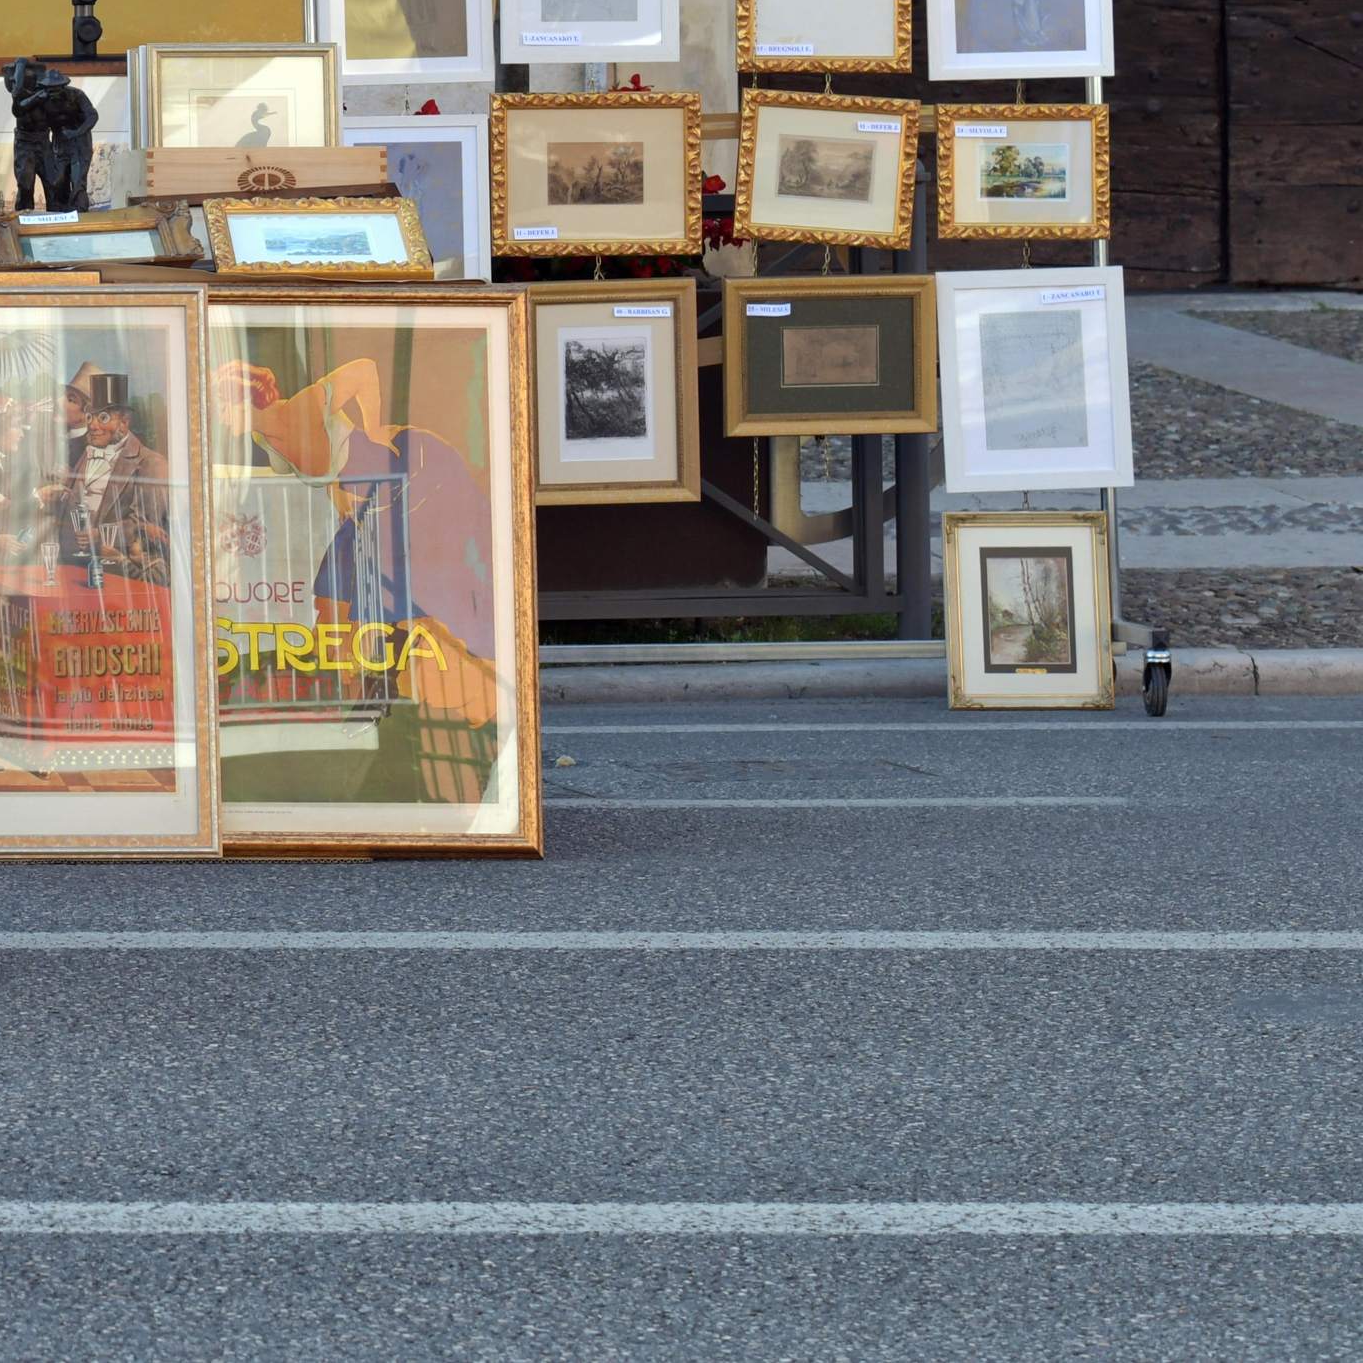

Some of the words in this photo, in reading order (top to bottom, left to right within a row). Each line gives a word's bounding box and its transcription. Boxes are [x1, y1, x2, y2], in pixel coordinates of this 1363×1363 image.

[216, 616, 448, 676] STREGA
[54, 686, 66, 703] la
[99, 684, 164, 703] deliziosa
